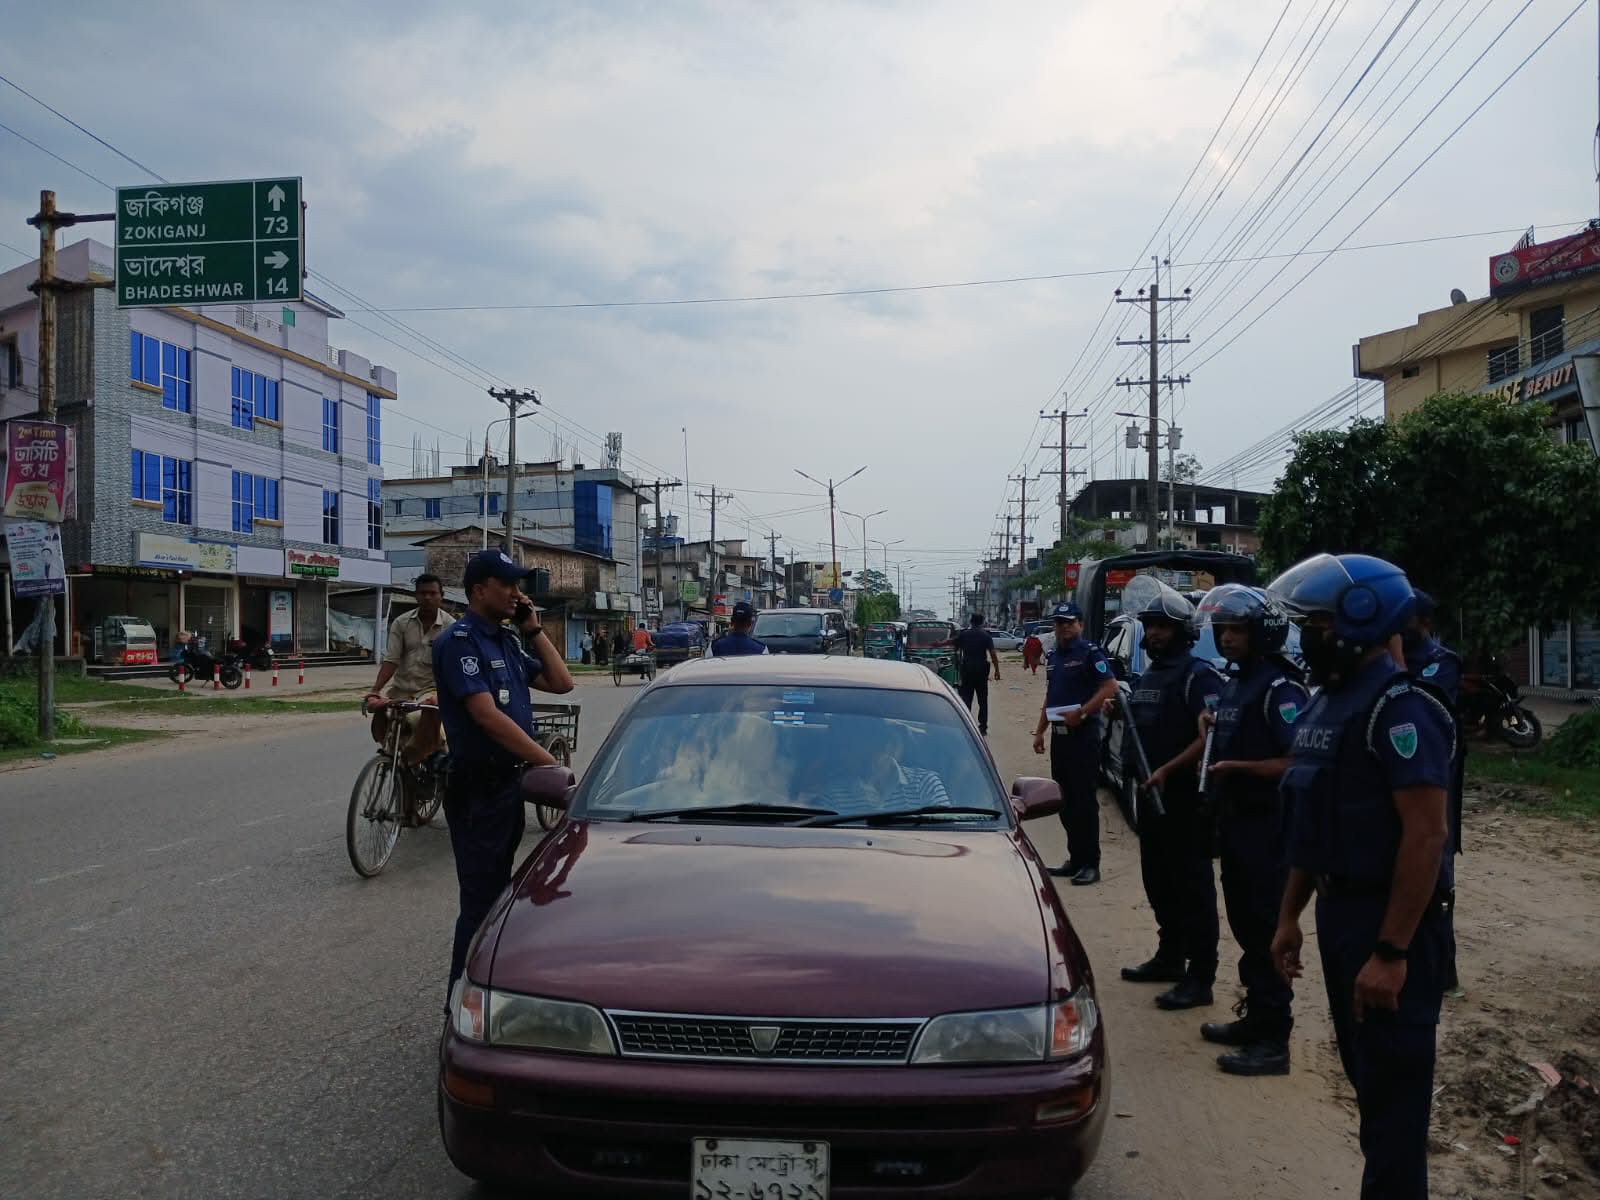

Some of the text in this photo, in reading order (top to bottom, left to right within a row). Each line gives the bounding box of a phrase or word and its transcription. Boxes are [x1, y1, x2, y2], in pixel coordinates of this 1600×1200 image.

[124, 190, 204, 218] জকিগঞ্জ
[124, 224, 206, 240] ZOKIGANJ
[263, 216, 289, 234] 73
[123, 254, 206, 278] ভাদেশ্বর
[125, 282, 244, 300] BHADESHWAR
[266, 277, 289, 295] 14
[1526, 364, 1574, 397] BEAUT
[1295, 727, 1334, 749] POLICE
[701, 1153, 739, 1170] ঢাকা
